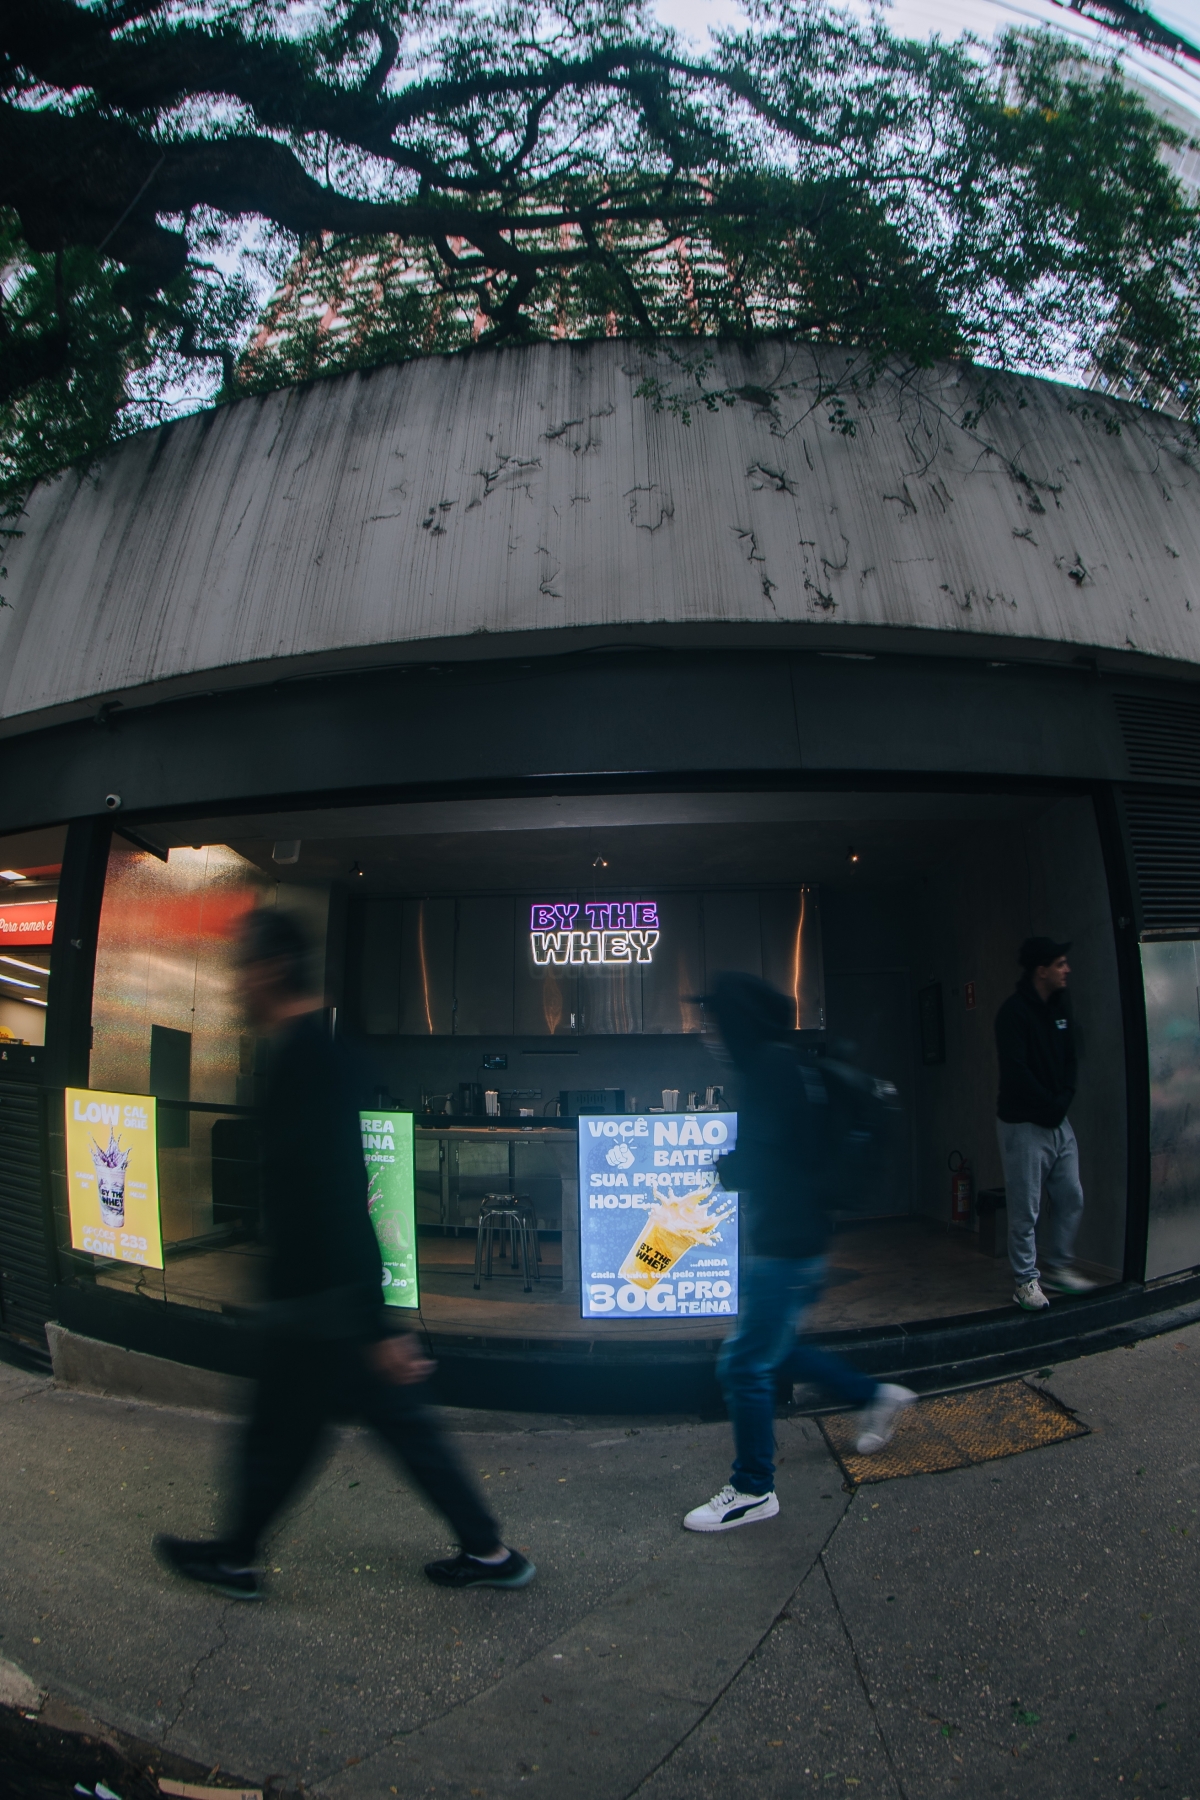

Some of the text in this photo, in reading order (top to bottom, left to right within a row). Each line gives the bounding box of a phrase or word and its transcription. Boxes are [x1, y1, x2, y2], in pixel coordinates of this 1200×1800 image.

[531, 902, 659, 931] BY THE
[0, 918, 53, 932] Para comer e
[530, 930, 660, 965] WHEY
[73, 1100, 148, 1126] LOW CAL
[124, 1118, 148, 1130] ORIE
[360, 1119, 394, 1133] REA
[588, 1116, 728, 1146] VOCÊ NÃO
[362, 1134, 395, 1150] INA
[364, 1153, 395, 1163] BORES
[590, 1173, 628, 1187] SUA
[102, 1196, 123, 1207] WHEY
[590, 1194, 645, 1209] HOJE
[83, 1237, 115, 1256] COM
[120, 1233, 148, 1251] 233
[635, 1249, 666, 1271] WHEY
[640, 1242, 671, 1265] BY THE
[591, 1271, 615, 1279] cada
[673, 1269, 695, 1280] pelo
[697, 1269, 730, 1278] menos
[589, 1280, 732, 1312] 30G PRO
[677, 1298, 731, 1314] TEÍNA
